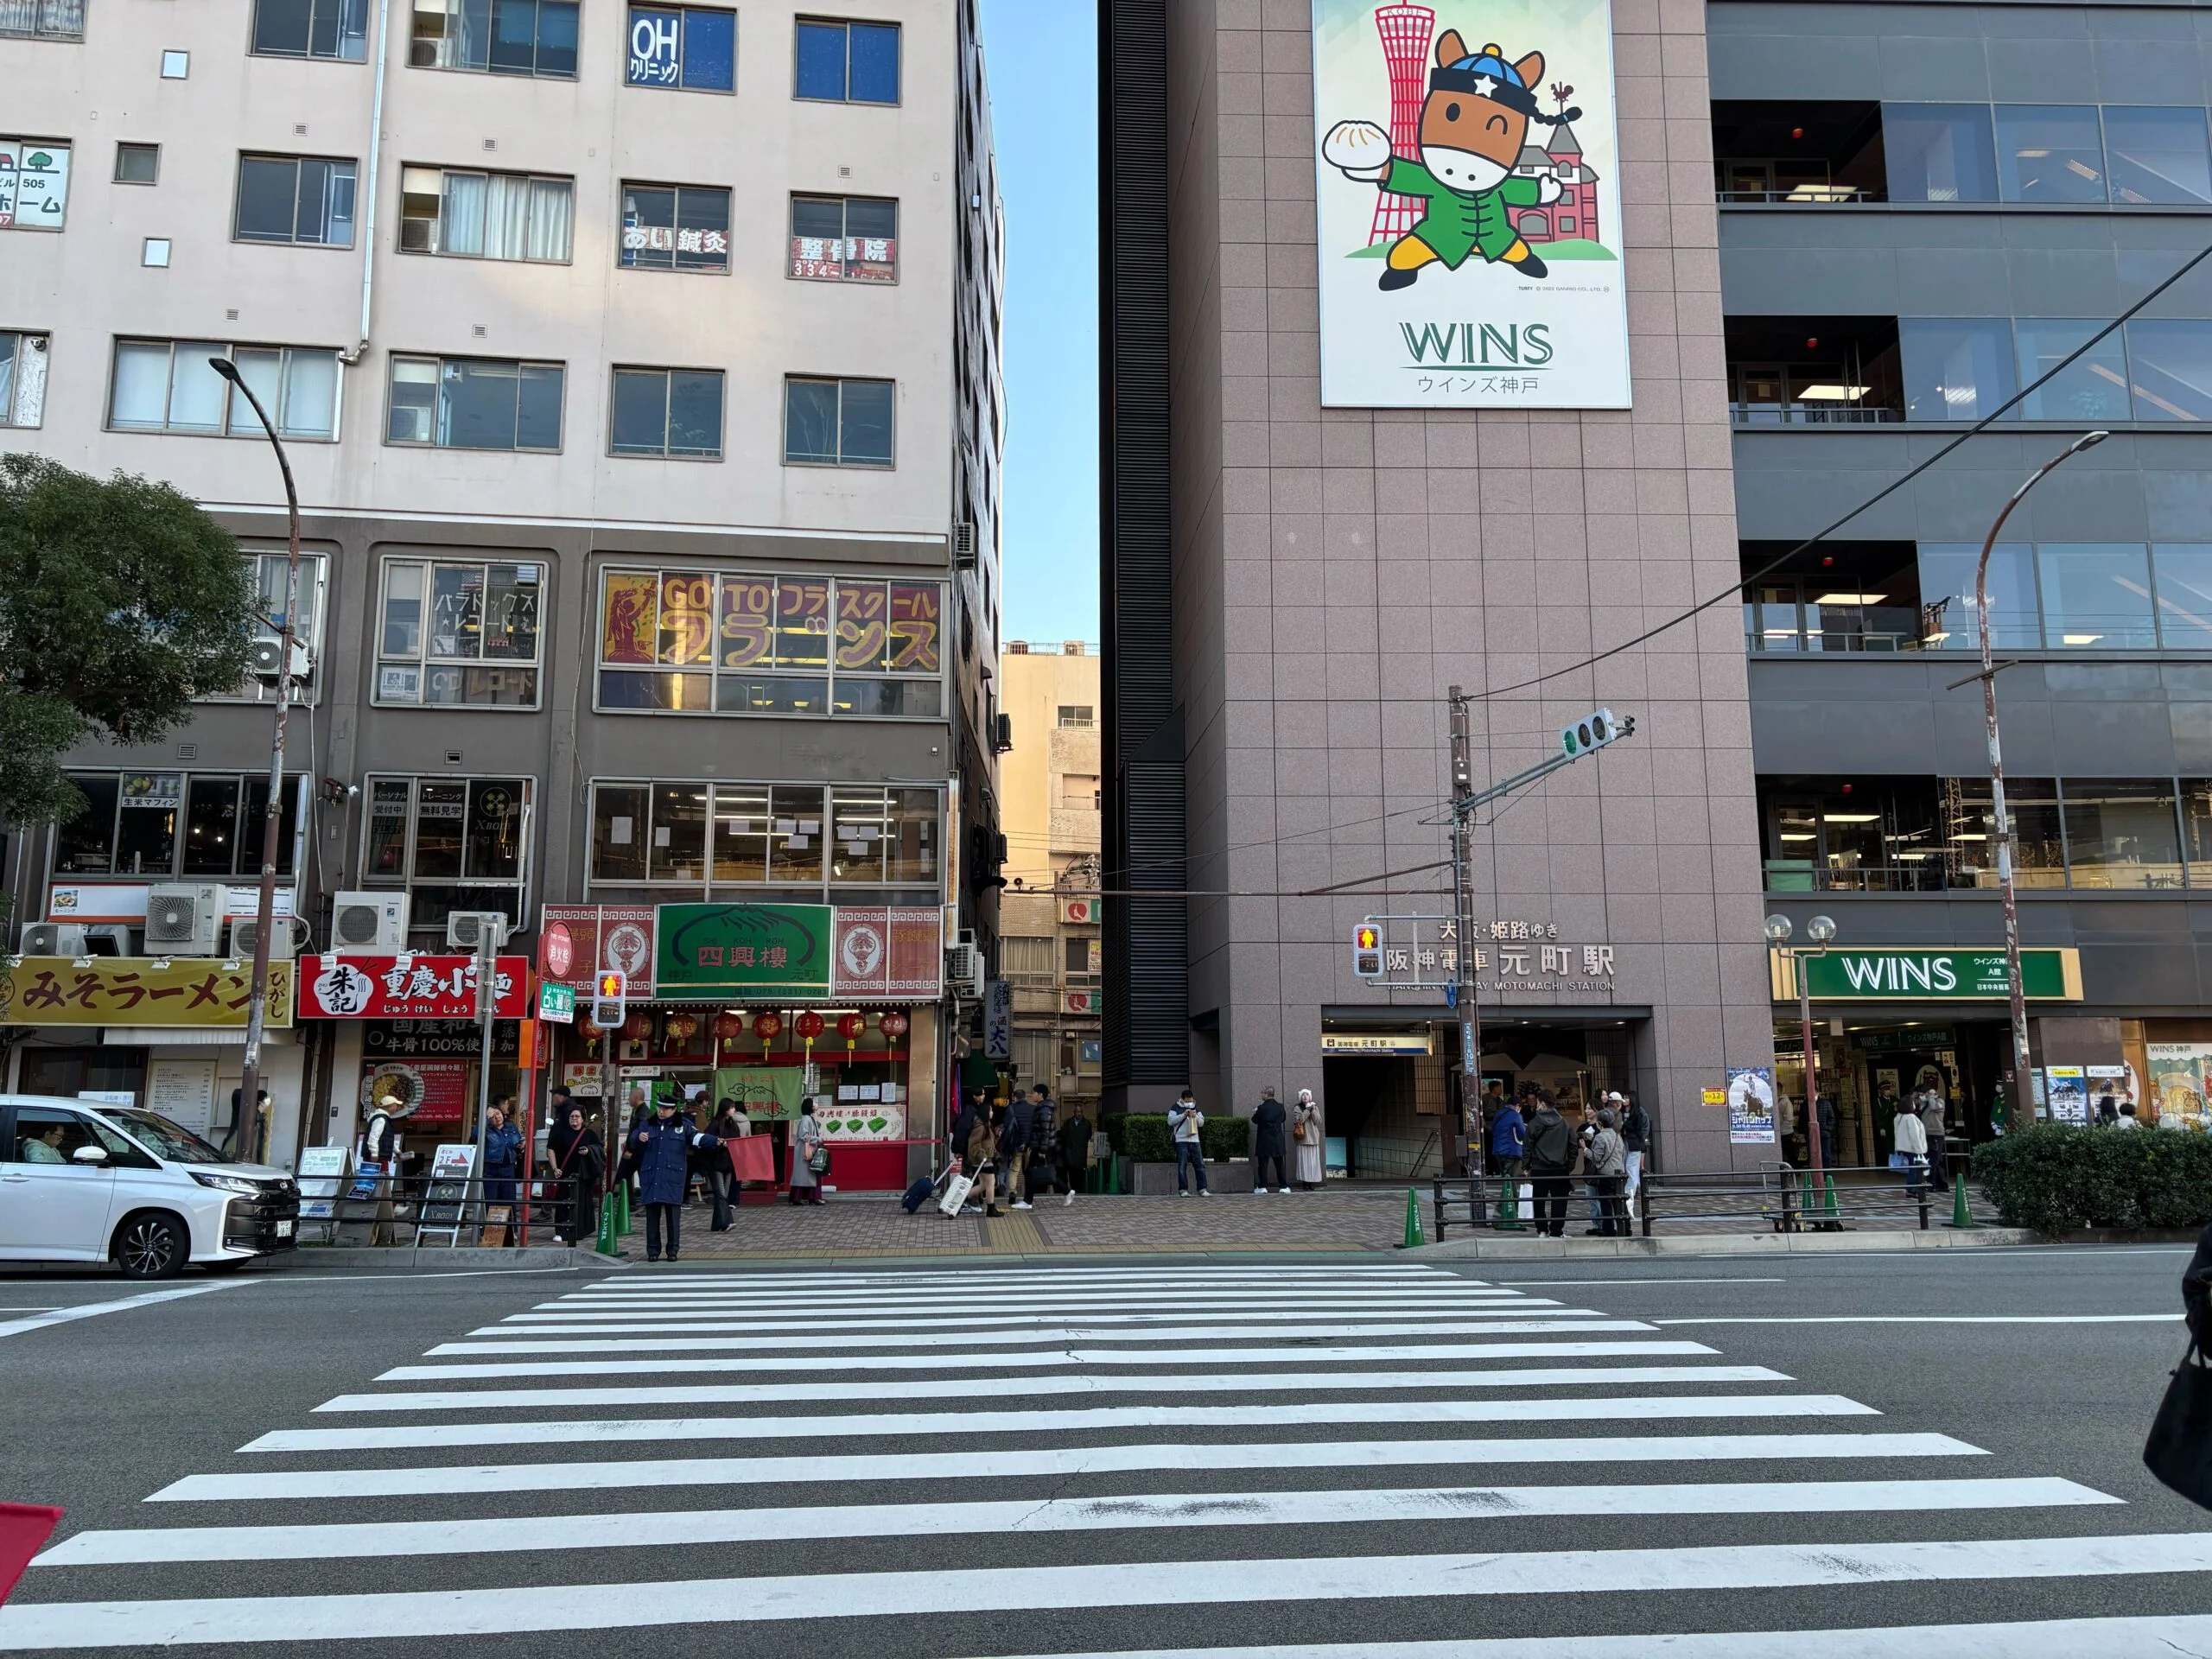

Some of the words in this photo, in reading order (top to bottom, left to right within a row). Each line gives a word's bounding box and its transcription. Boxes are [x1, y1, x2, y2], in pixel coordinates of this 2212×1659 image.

[632, 19, 678, 60] OH
[630, 60, 678, 83] クリニック
[22, 179, 46, 188] 505
[623, 227, 727, 253] あい鍼灸
[799, 238, 887, 262] 整骨院
[1398, 322, 1554, 365] WINS
[1417, 376, 1539, 394] ウインズ神戸
[664, 578, 711, 610] GO
[725, 584, 771, 614] TO
[661, 609, 938, 670] フランス
[124, 798, 177, 807] 生米マフィン
[373, 791, 408, 800] パーソナル
[375, 805, 403, 814] 受付中
[420, 806, 461, 817] 無料見学
[550, 944, 569, 963] 消火栓
[1386, 949, 1489, 971] 阪神電車
[1500, 945, 1615, 976] 元町駅
[1974, 957, 2009, 966] ウインズ神
[1841, 957, 1956, 991] WINS
[22, 971, 254, 1010] みそラーメン
[269, 971, 287, 1019] ひがし
[383, 1005, 409, 1014] じゅう
[415, 1005, 433, 1014] けい
[442, 1005, 468, 1014] しょう
[2176, 1045, 2191, 1053] 神戸
